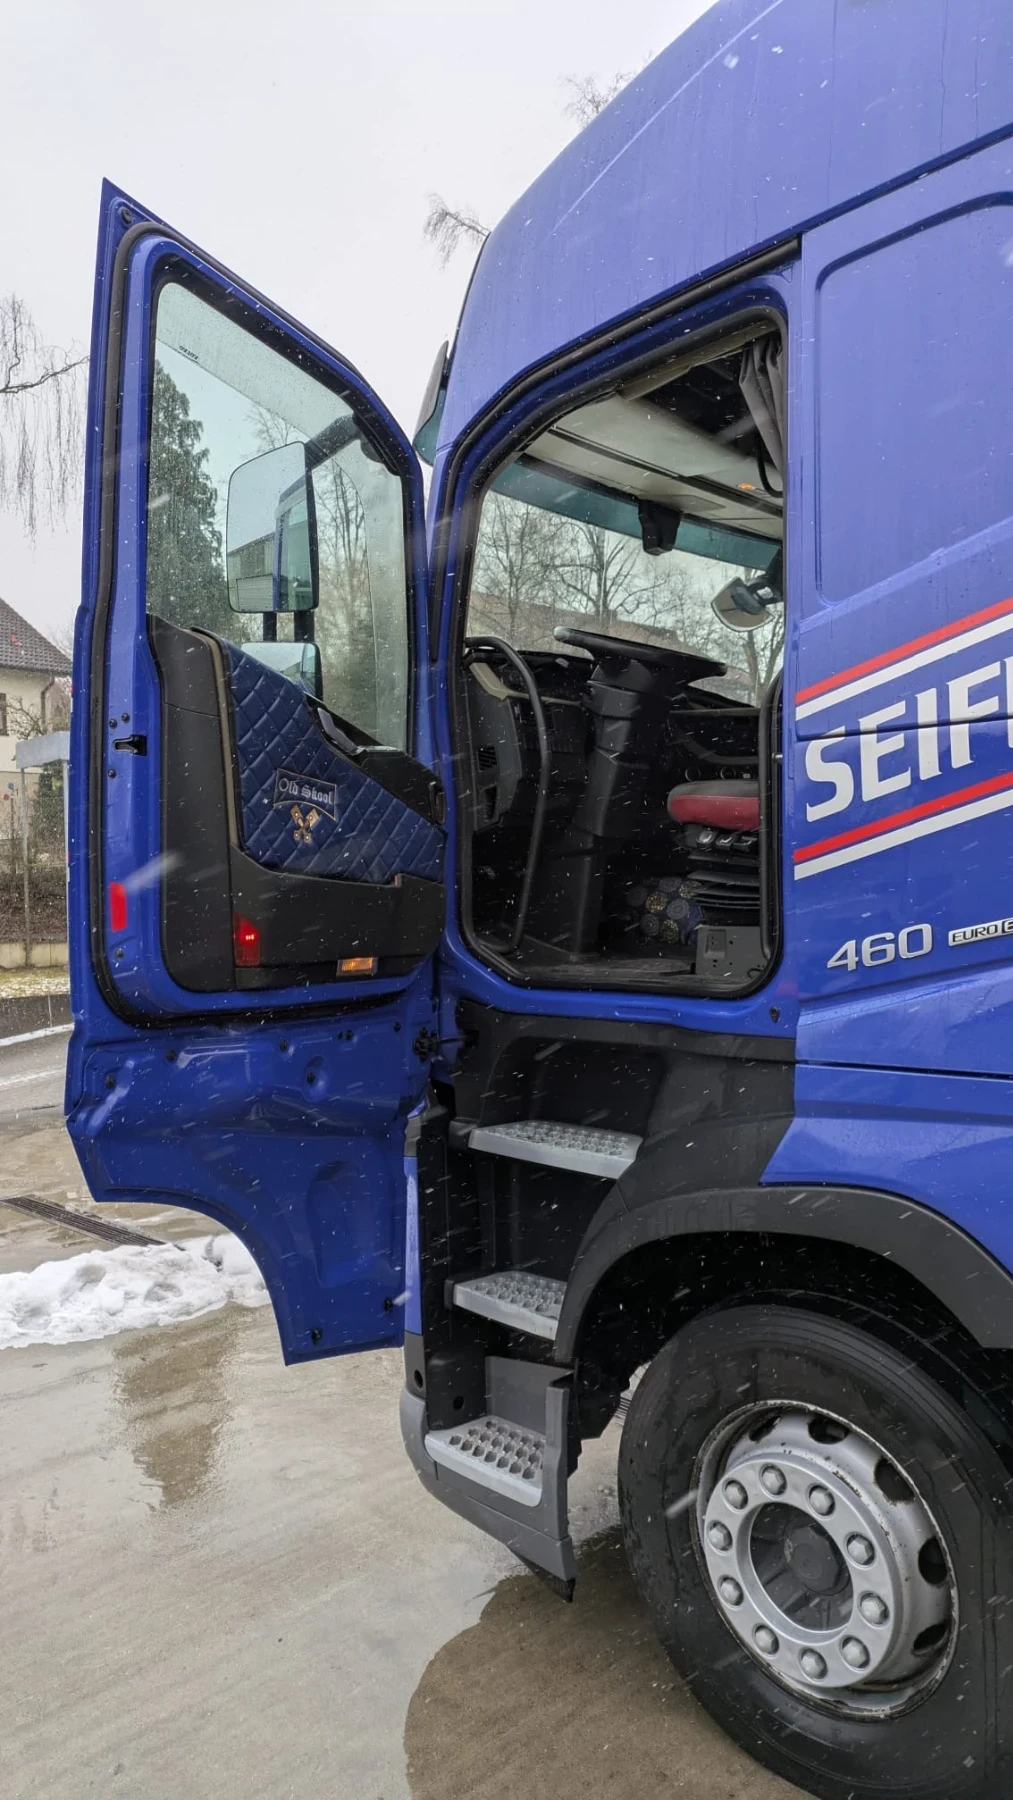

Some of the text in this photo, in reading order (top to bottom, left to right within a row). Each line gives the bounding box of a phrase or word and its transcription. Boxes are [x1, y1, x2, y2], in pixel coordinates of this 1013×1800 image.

[805, 656, 1013, 822] SEIF
[279, 778, 333, 804] Old Skool
[827, 924, 932, 971] 460
[952, 924, 998, 943] EURO
